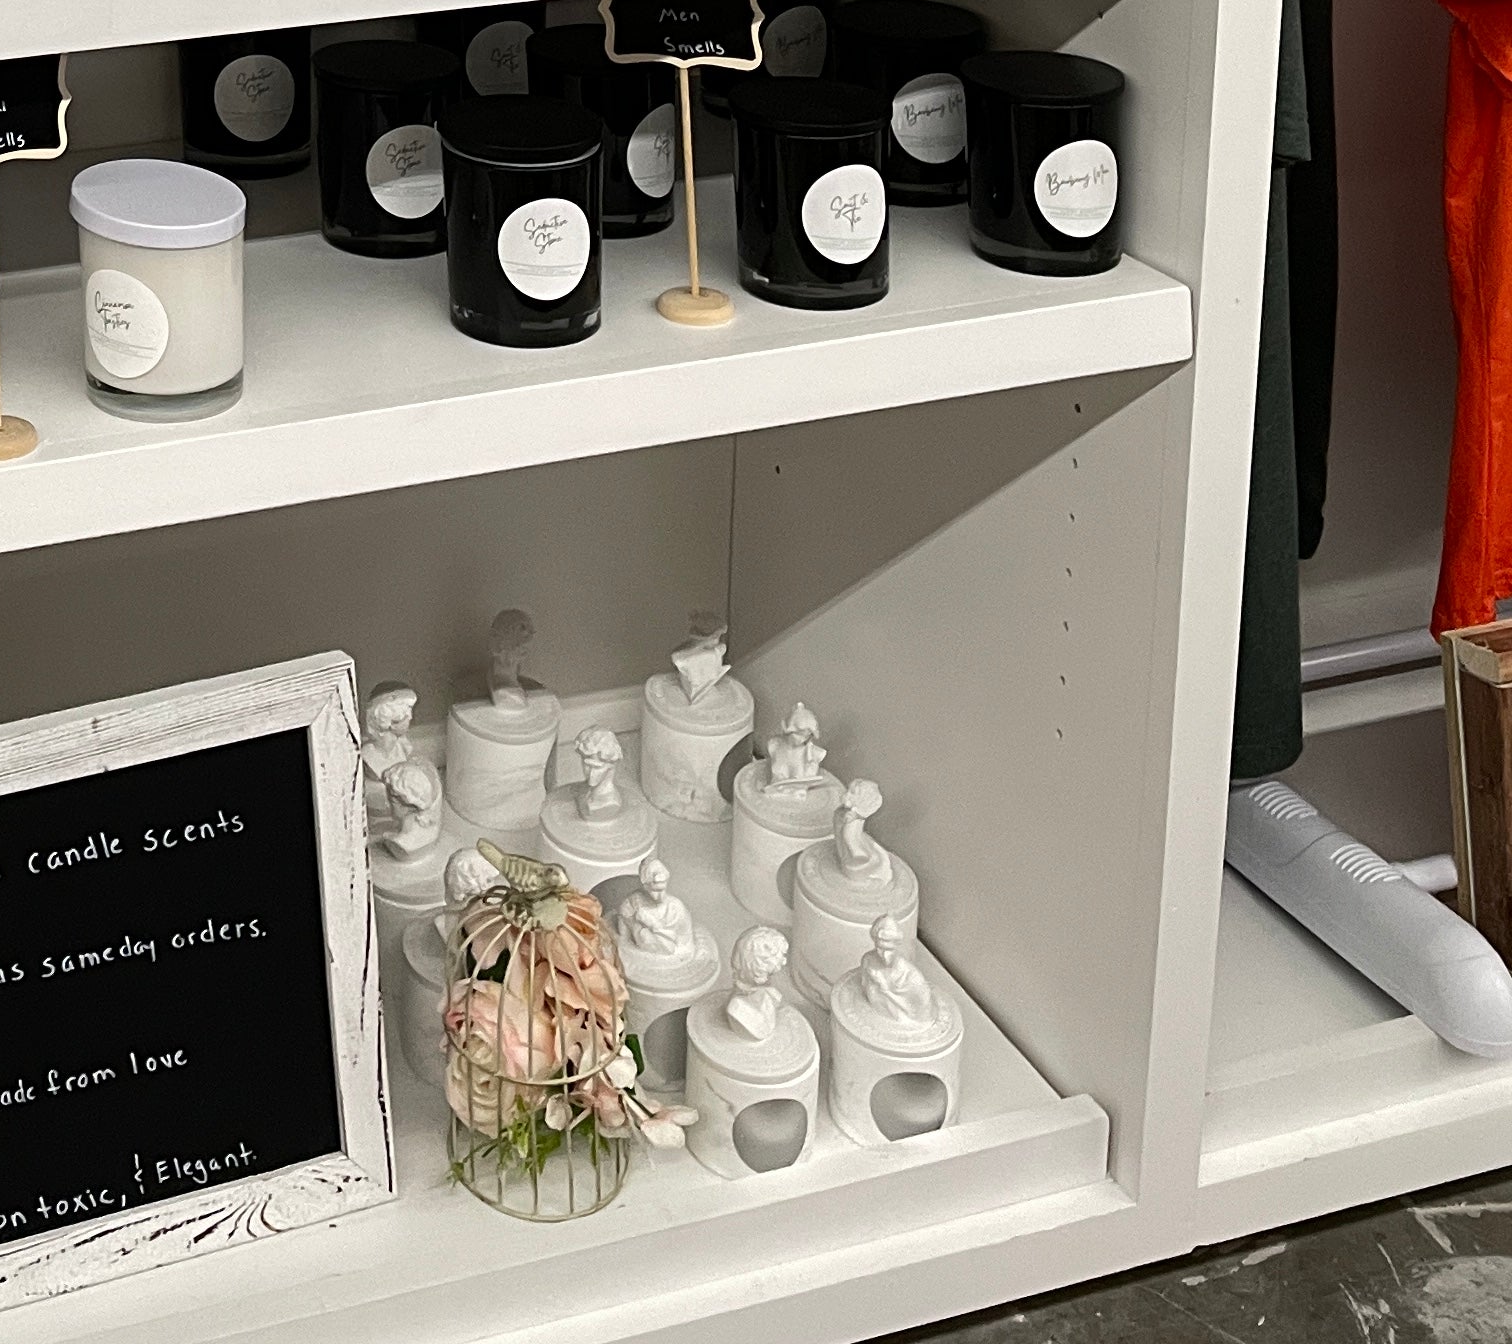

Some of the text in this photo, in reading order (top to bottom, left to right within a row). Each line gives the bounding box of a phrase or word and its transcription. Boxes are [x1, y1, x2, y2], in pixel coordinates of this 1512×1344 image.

[658, 7, 701, 23] Men
[663, 35, 725, 56] Smells
[27, 831, 124, 876] candle
[143, 809, 246, 854] scents
[170, 917, 269, 950] orders.
[47, 1064, 117, 1097] from
[129, 1046, 188, 1076] love
[35, 1185, 128, 1220] toxic,
[155, 1141, 258, 1184] Elegant.
